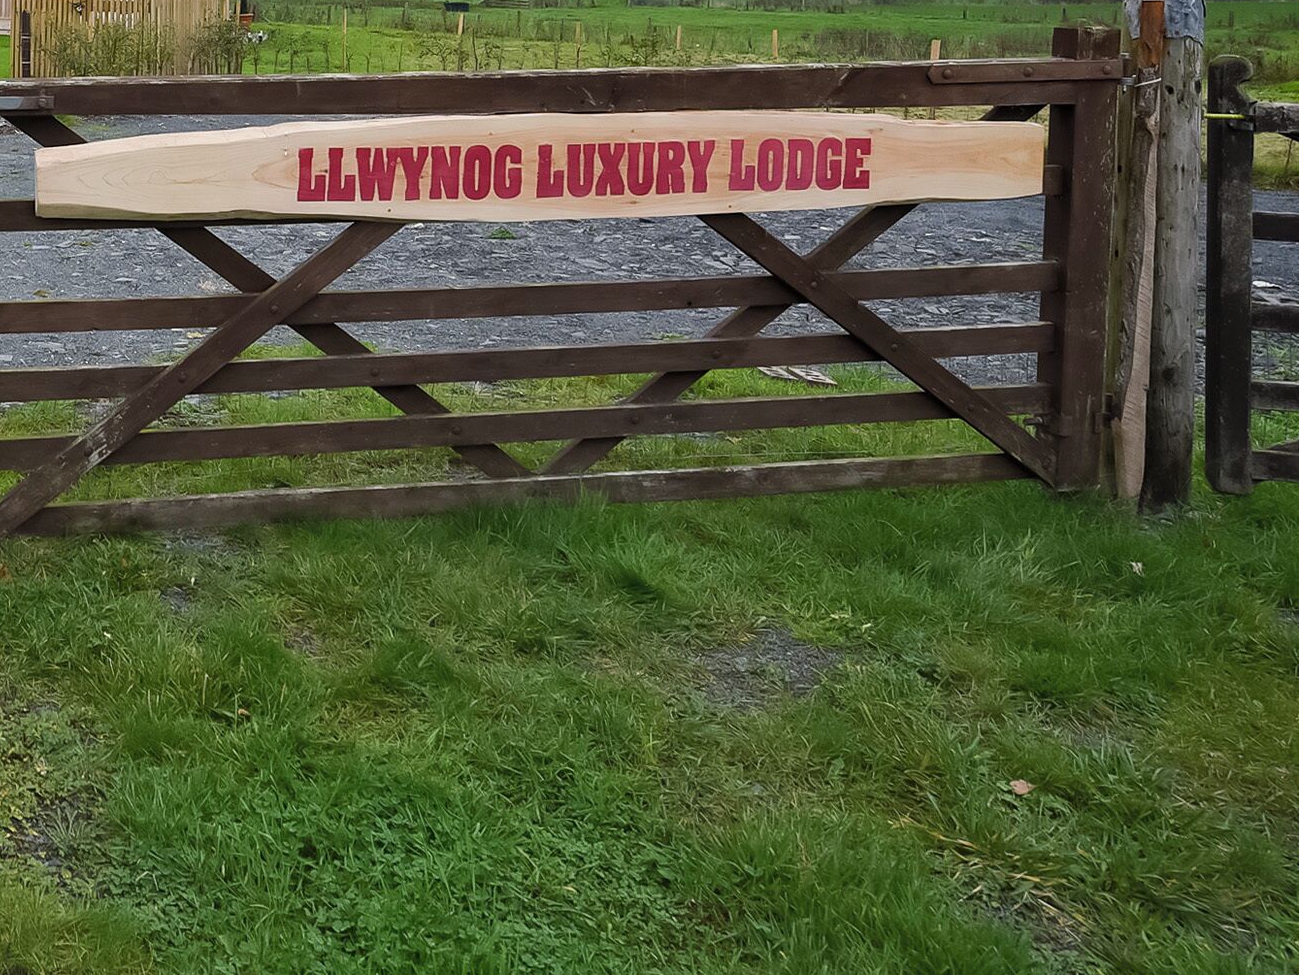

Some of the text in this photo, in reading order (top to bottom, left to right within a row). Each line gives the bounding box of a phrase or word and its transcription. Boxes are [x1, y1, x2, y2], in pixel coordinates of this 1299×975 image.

[297, 137, 872, 201] LLWYNOG LUXURY LODGE
